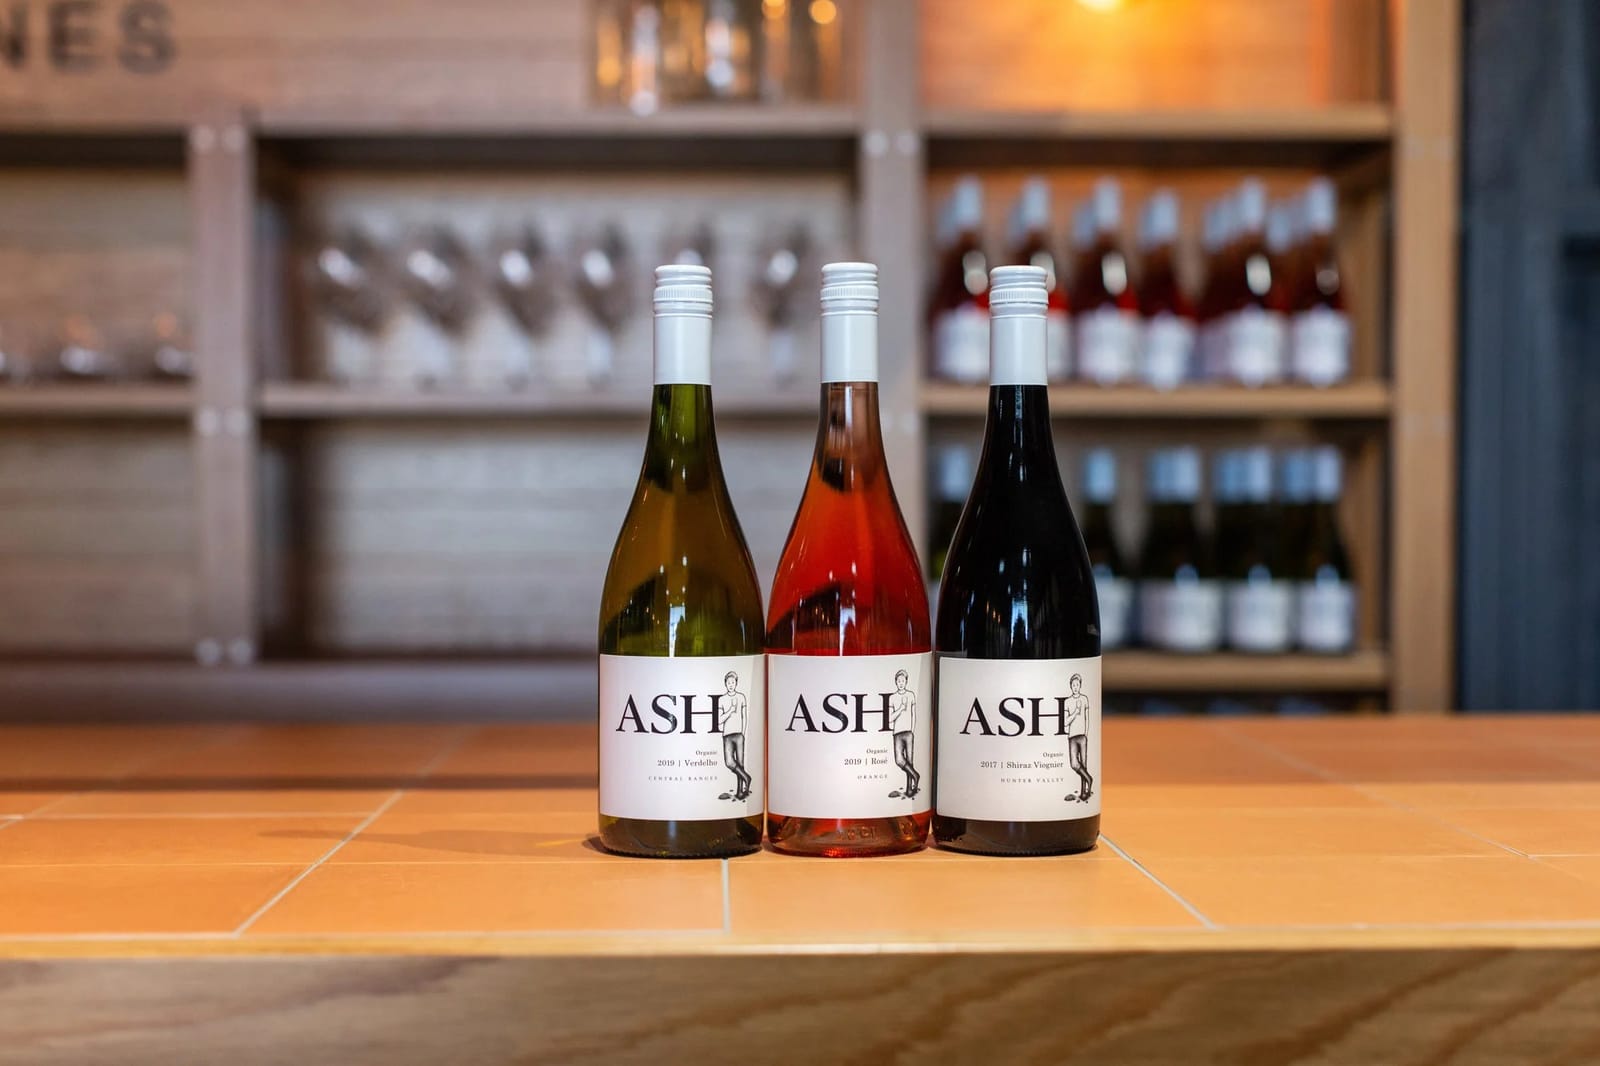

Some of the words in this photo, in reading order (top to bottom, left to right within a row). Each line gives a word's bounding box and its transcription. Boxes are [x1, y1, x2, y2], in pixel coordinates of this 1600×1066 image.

[615, 693, 723, 735] ASH
[785, 693, 893, 734] ASH
[959, 697, 1069, 737] ASH
[865, 747, 888, 755] Organic
[657, 759, 675, 767] 2019
[684, 758, 718, 767] Verdelho
[844, 758, 862, 766] 2019
[871, 757, 889, 765] Rosé
[980, 760, 998, 769] 2017
[1006, 761, 1032, 769] Shiraz
[1033, 761, 1064, 770] Viognier
